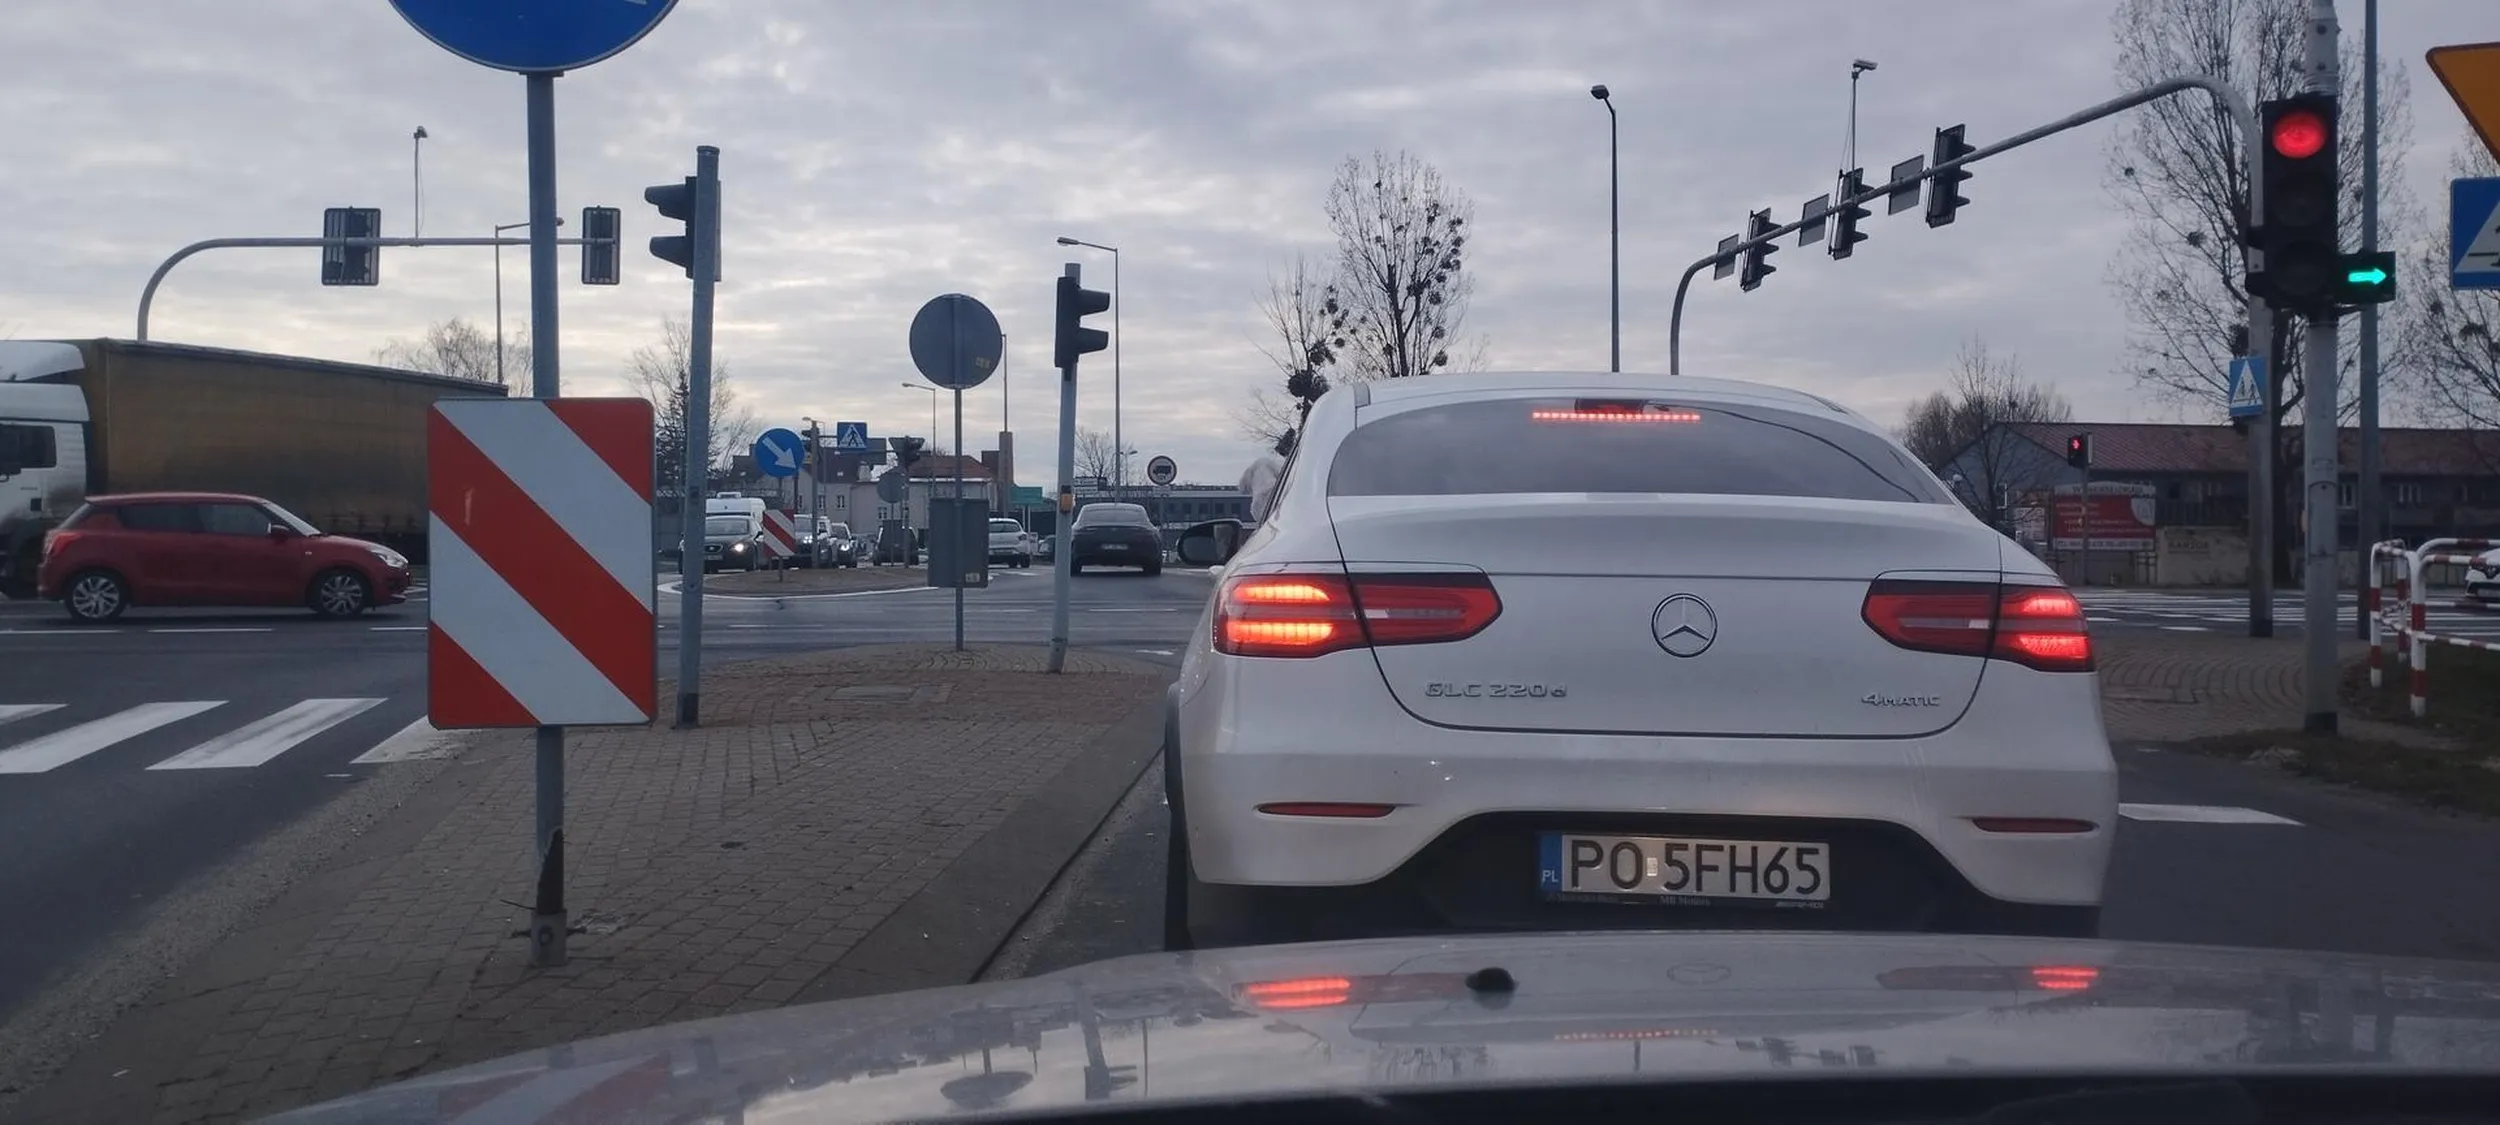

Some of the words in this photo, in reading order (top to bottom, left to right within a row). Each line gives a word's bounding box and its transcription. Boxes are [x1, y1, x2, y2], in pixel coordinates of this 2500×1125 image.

[1425, 682, 1482, 698] GLC
[1861, 692, 1941, 707] 4MATIC
[1571, 839, 1644, 891] PO
[1663, 842, 1821, 895] 5FH65
[1541, 870, 1559, 883] PL
